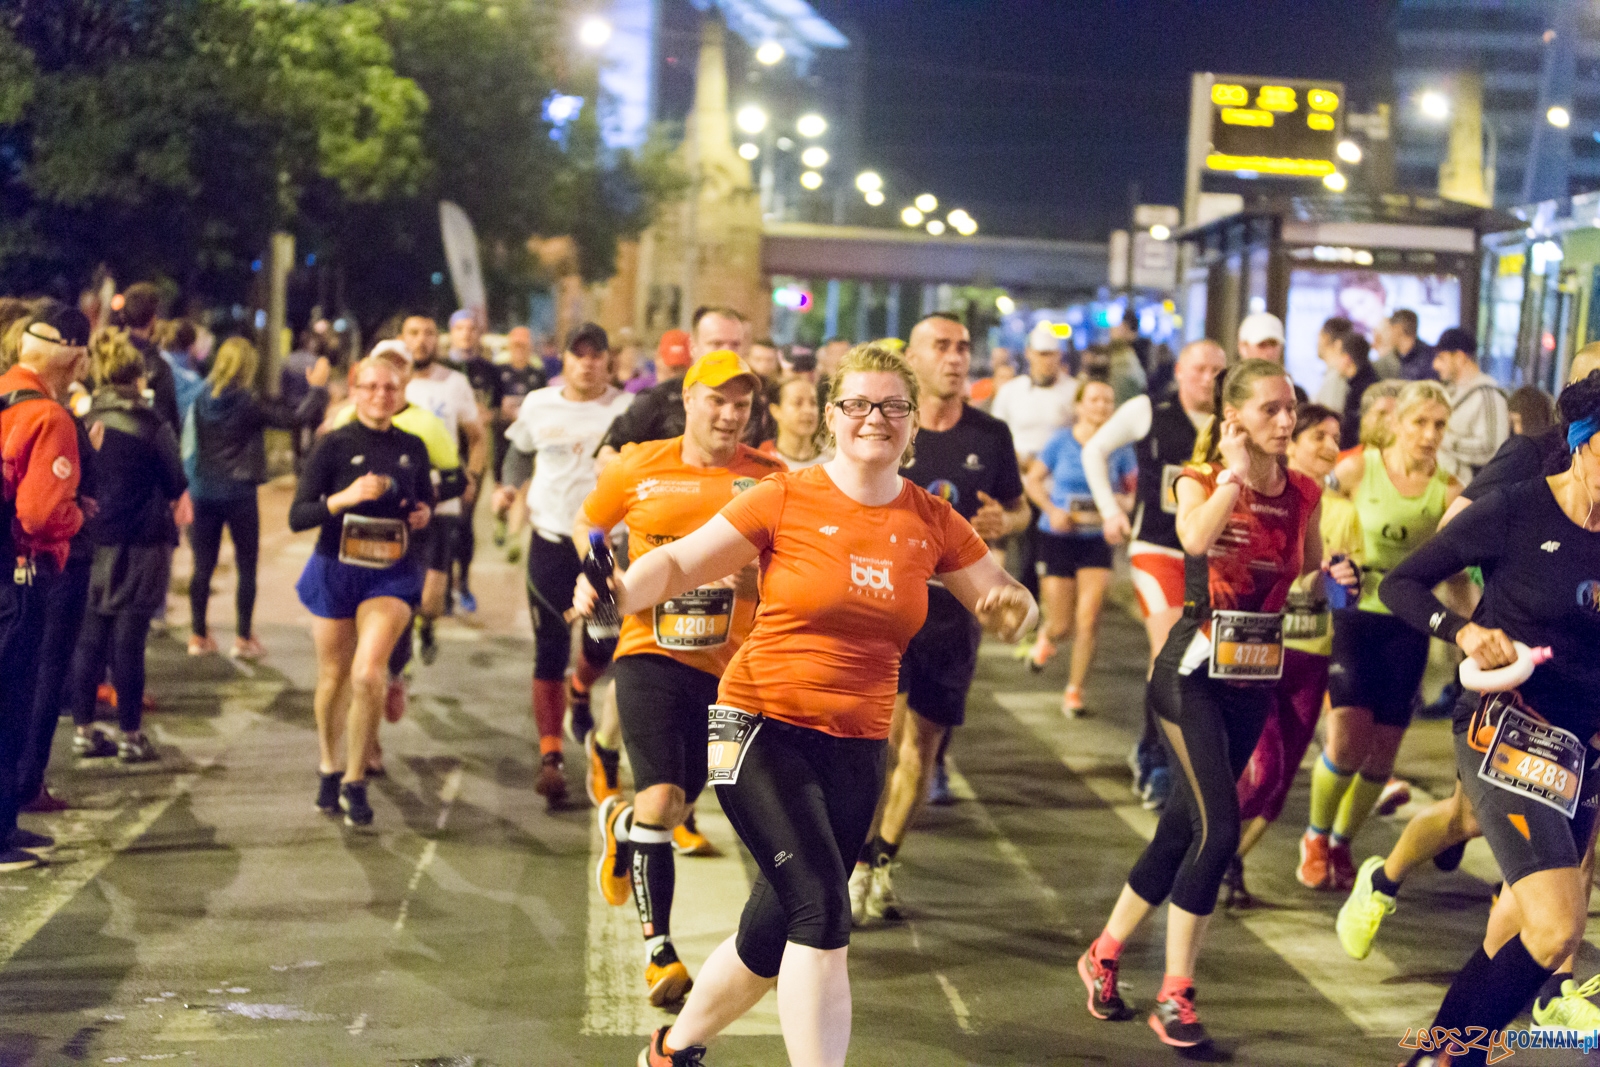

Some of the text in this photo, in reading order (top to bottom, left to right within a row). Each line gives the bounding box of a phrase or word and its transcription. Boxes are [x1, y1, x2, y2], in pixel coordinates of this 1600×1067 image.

[818, 524, 840, 536] 4F
[1540, 540, 1561, 553] 4F
[850, 562, 894, 592] bbl
[848, 585, 896, 600] POLSKA
[674, 617, 715, 636] 4204
[1234, 645, 1269, 665] 4772
[707, 743, 725, 768] 70
[1516, 755, 1568, 792] 4283
